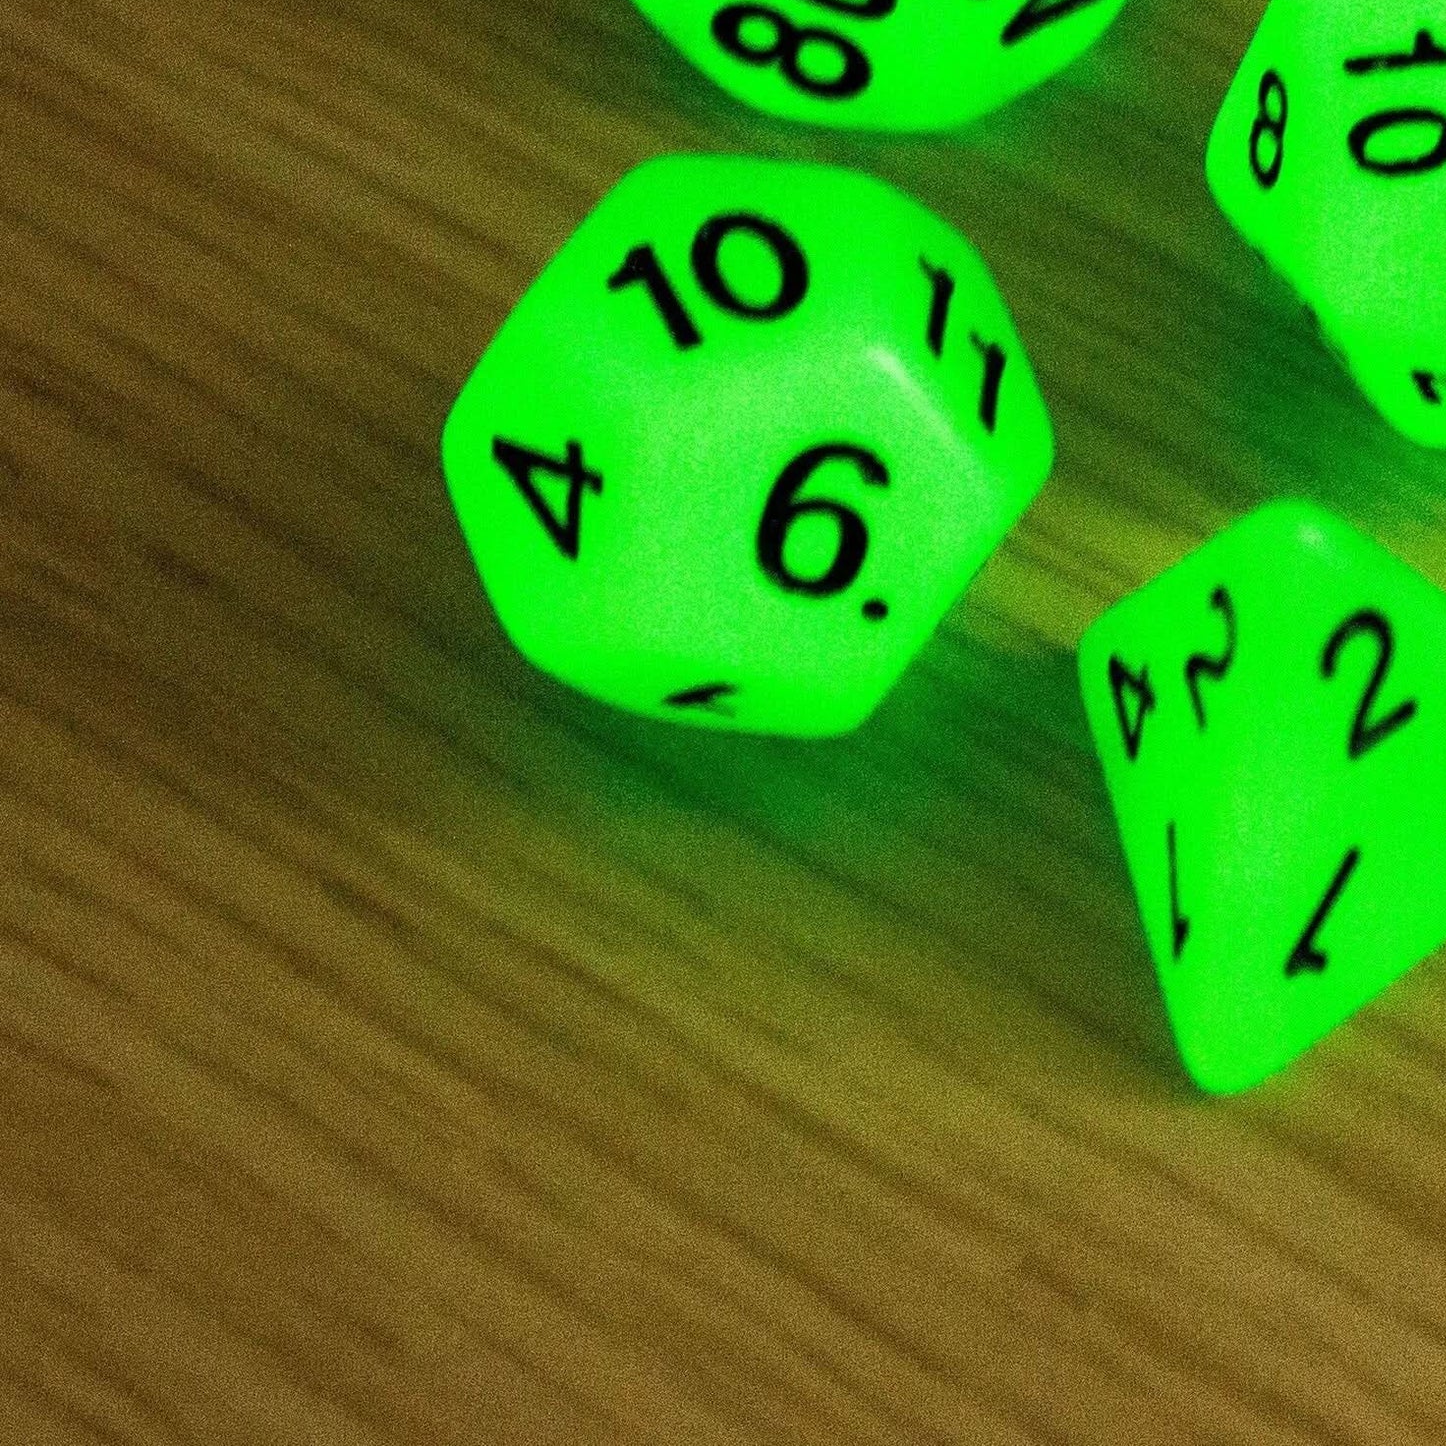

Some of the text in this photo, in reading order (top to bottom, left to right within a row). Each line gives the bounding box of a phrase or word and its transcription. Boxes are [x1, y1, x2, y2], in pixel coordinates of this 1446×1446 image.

[1247, 67, 1290, 191] 8
[605, 209, 812, 353] 10
[490, 434, 605, 563] 4
[1106, 651, 1157, 763] 4
[1318, 606, 1419, 761] 2
